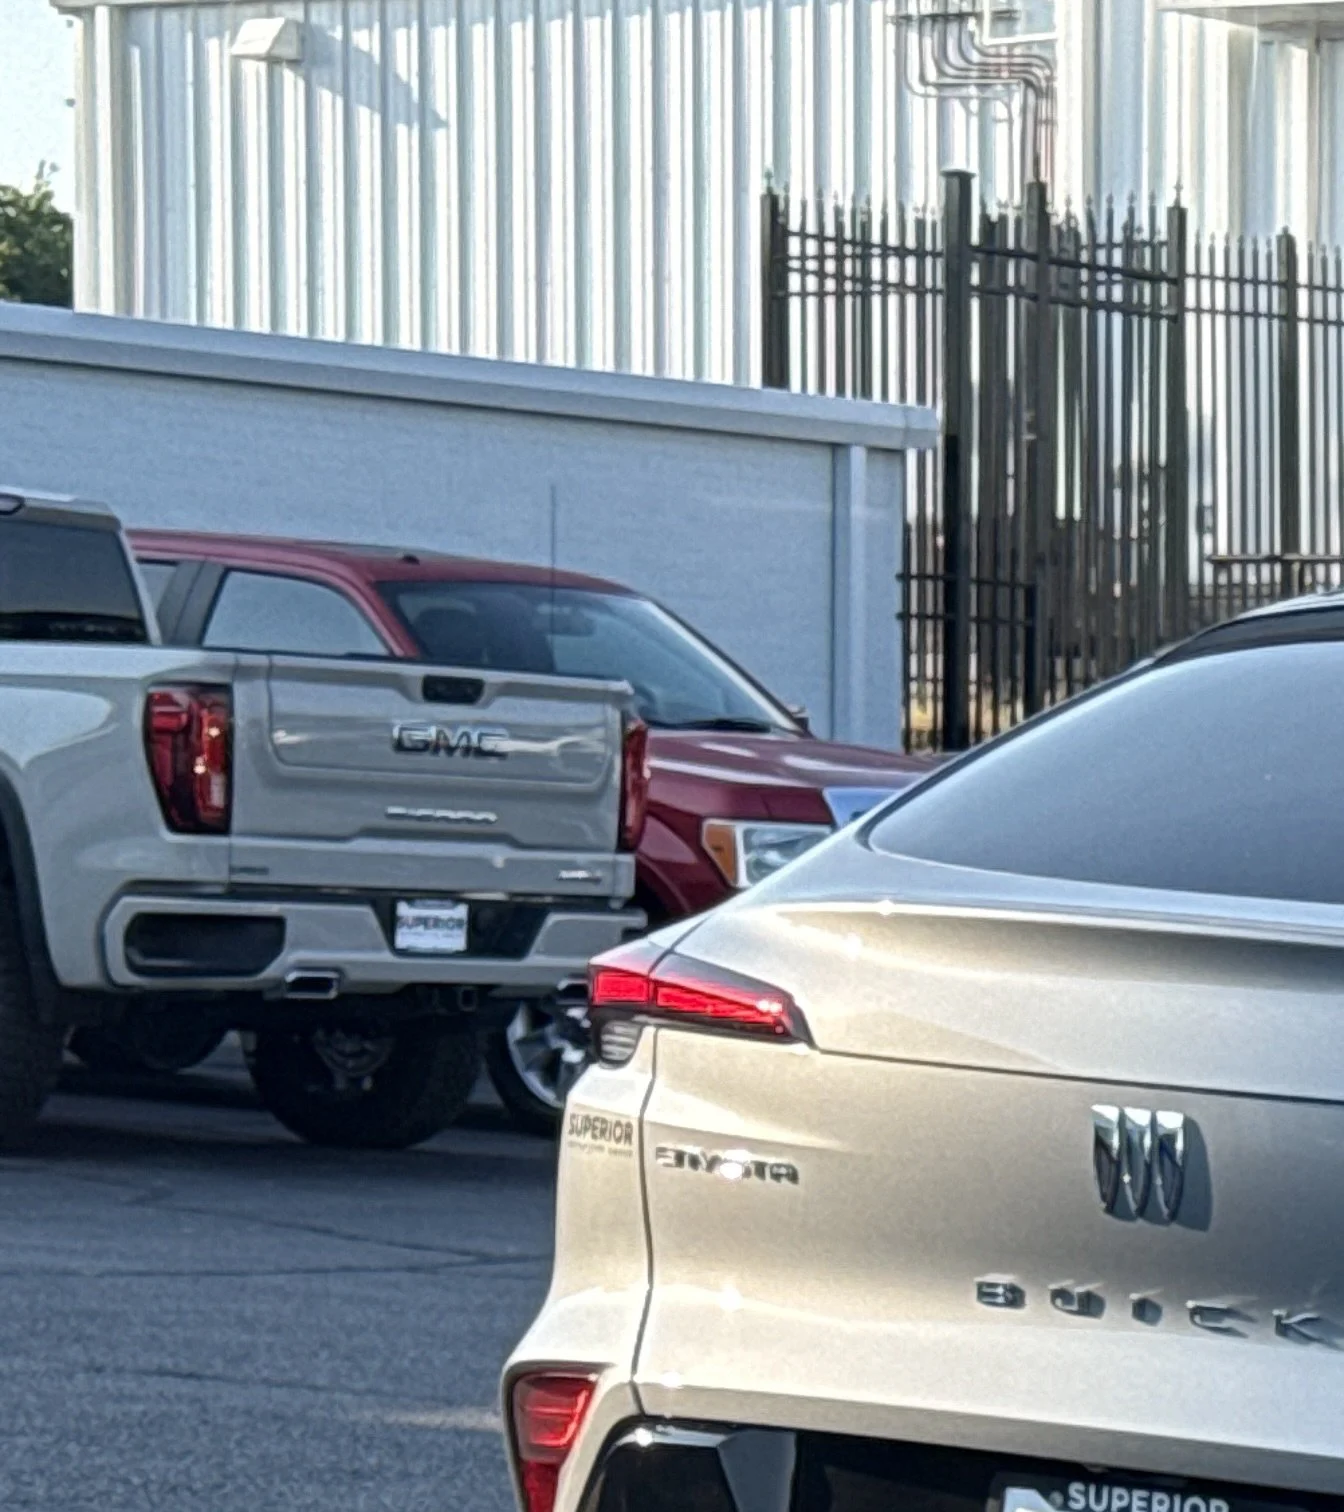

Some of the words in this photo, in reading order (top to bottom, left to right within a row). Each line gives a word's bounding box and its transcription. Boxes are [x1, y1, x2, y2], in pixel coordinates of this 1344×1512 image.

[391, 721, 508, 758] GMC
[568, 1113, 633, 1146] SUPERIOR
[974, 1273, 1334, 1348] BUICK
